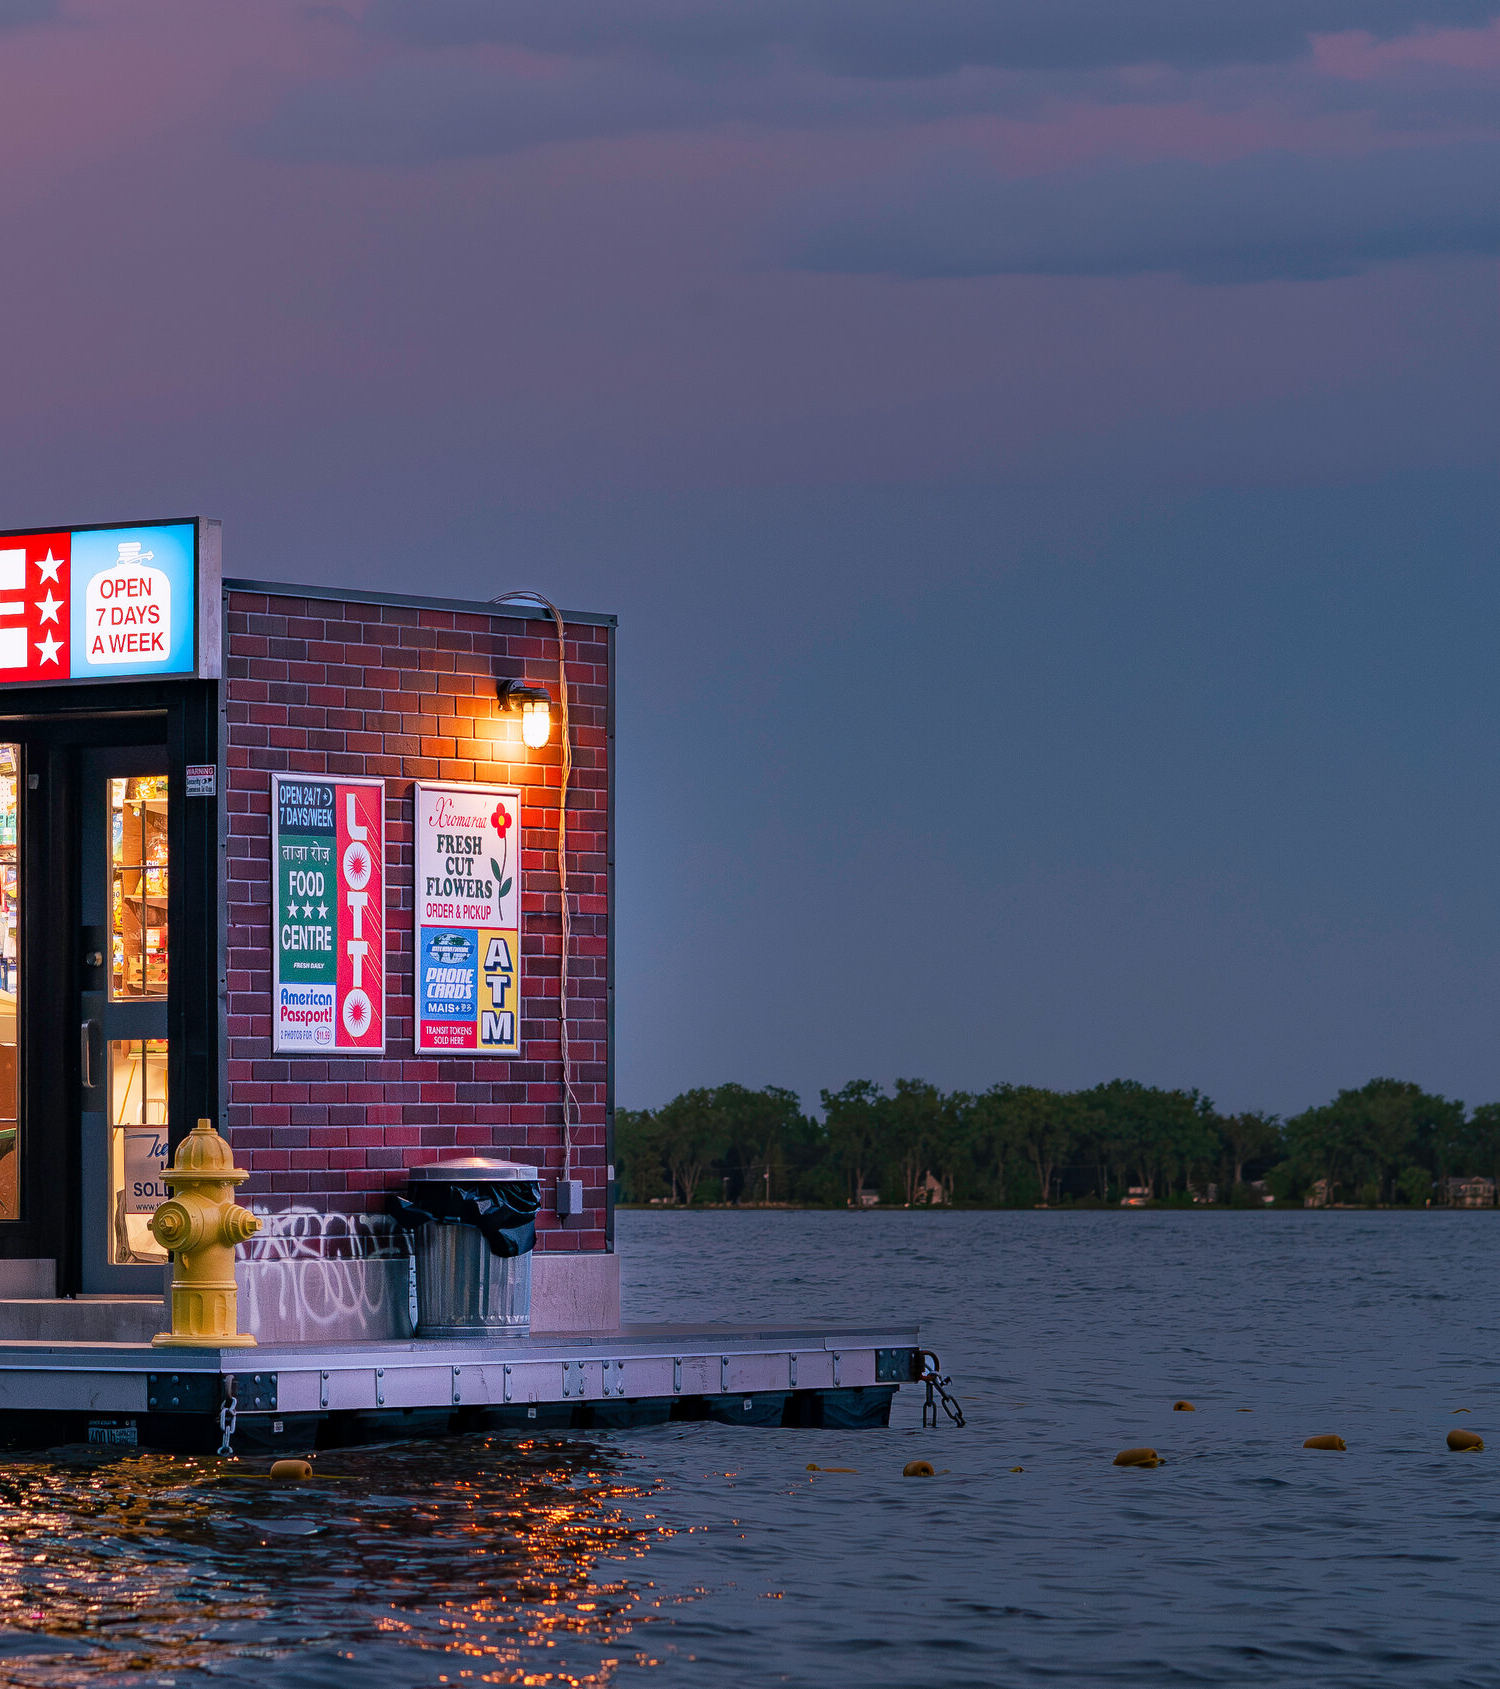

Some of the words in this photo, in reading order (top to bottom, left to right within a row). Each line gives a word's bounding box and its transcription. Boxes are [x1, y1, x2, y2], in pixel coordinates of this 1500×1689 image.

[100, 577, 152, 599] OPEN
[96, 607, 106, 627] 7
[111, 604, 160, 626] DAYS
[92, 635, 104, 654] A
[109, 632, 164, 653] WEEK
[187, 767, 213, 775] WARNING
[280, 785, 301, 805] OPEN
[303, 786, 321, 806] 24/7
[280, 807, 285, 825] 7
[286, 808, 334, 827] DAYS/WEEK
[437, 834, 483, 855] FRESH
[445, 856, 474, 876] CUT
[289, 870, 325, 897] FOOD
[426, 877, 493, 899] FLOWERS
[342, 793, 372, 1038] LOTTO
[426, 902, 454, 918] ORDER
[455, 904, 462, 919] &
[463, 904, 492, 920] PICKUP
[281, 924, 332, 951] CENTRE
[425, 967, 475, 984] PHONE
[280, 987, 333, 1006] American
[426, 983, 474, 999] CARDS
[481, 936, 515, 1046] ATM
[280, 1005, 333, 1027] Passport!
[284, 1030, 302, 1040] PHOTOS
[302, 1030, 313, 1040] FOR
[425, 1026, 449, 1035] TRANSIT
[449, 1026, 473, 1036] TOKENS
[433, 1036, 449, 1045] SOLD
[450, 1036, 464, 1046] HERE
